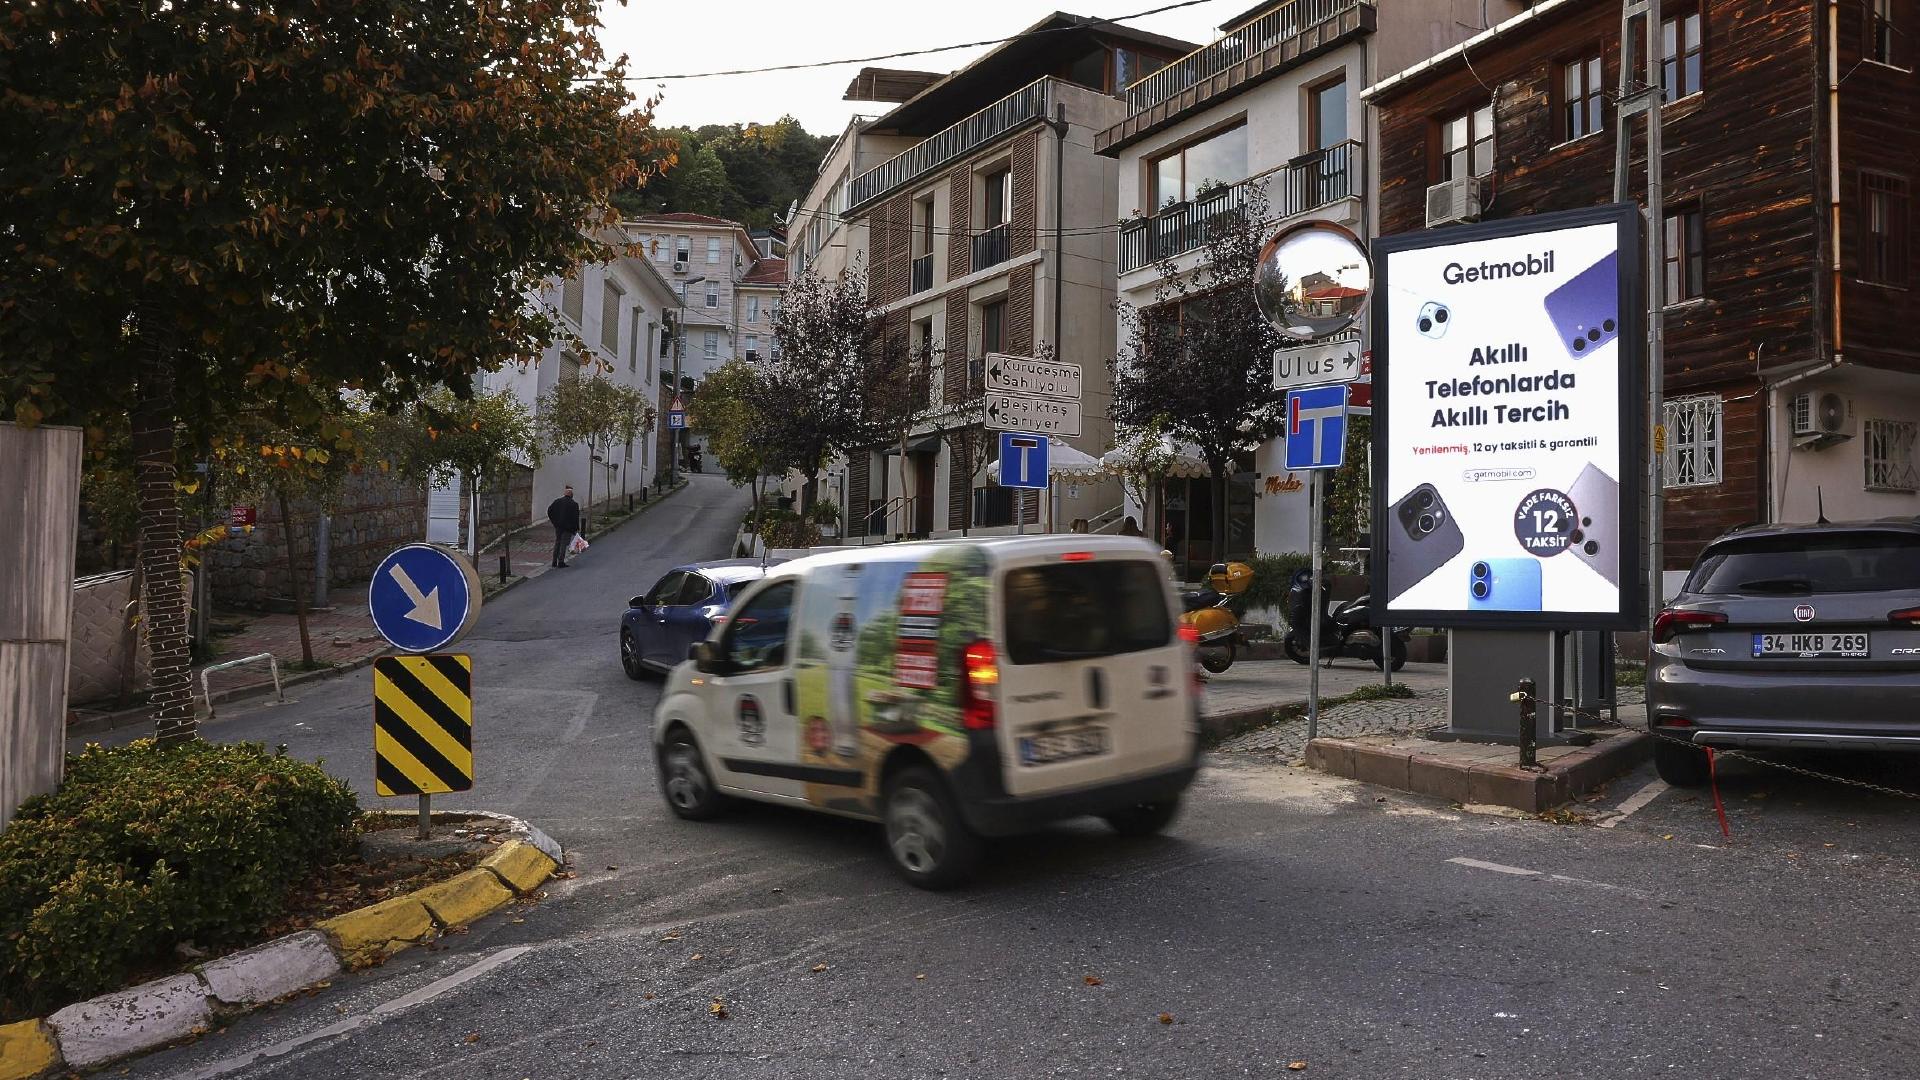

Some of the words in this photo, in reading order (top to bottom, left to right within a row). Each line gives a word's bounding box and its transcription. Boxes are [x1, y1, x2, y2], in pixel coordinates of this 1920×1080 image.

[1443, 250, 1554, 285] Getmobil
[1469, 343, 1528, 366] Akıllı
[1279, 356, 1335, 379] Ulus
[1425, 370, 1576, 399] Telefonlarda
[1001, 398, 1067, 416] Beşiktaş
[1431, 406, 1488, 428] Akıllı
[1494, 400, 1569, 424] Tercih
[1001, 413, 1059, 430] Sarıyer
[1473, 442, 1482, 452] 12
[1484, 444, 1497, 453] ay
[1500, 439, 1537, 451] taksitli
[1539, 440, 1547, 449] &
[1549, 436, 1598, 451] garantili
[1518, 495, 1539, 520] VADE
[1539, 492, 1574, 519] FARKSIZ
[1533, 509, 1558, 533] 12
[1525, 534, 1567, 548] TAKSİT
[1764, 635, 1785, 651] 34
[1791, 635, 1824, 651] HKB
[1831, 635, 1866, 651] 269
